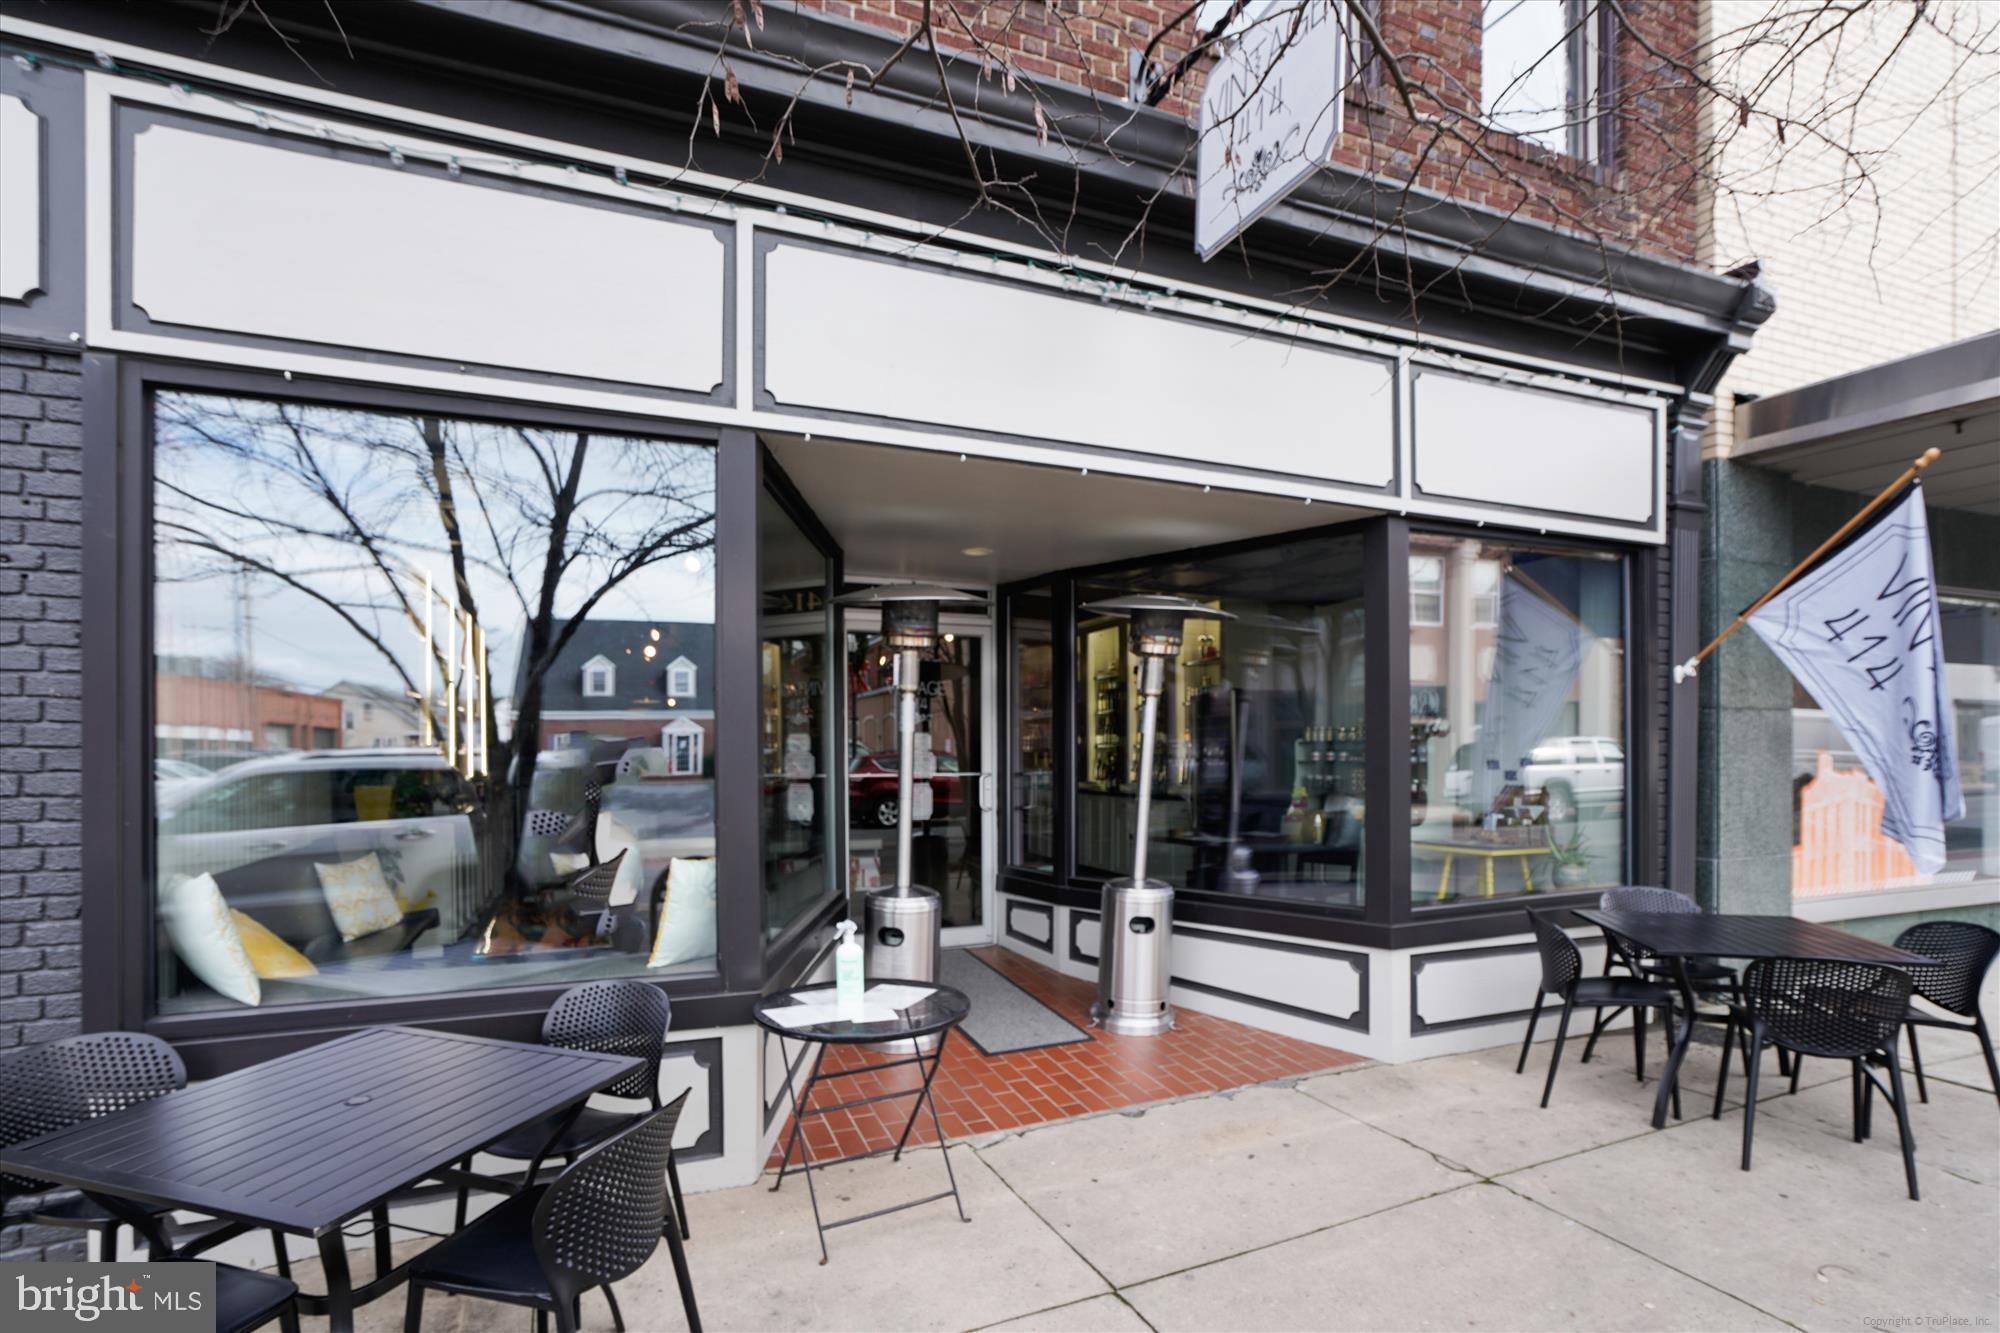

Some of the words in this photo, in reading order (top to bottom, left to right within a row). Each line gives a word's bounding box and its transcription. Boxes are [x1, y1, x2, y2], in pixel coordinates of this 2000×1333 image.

[1238, 76, 1284, 146] 414
[1877, 551, 1935, 652] VIN
[1824, 608, 1904, 691] 414
